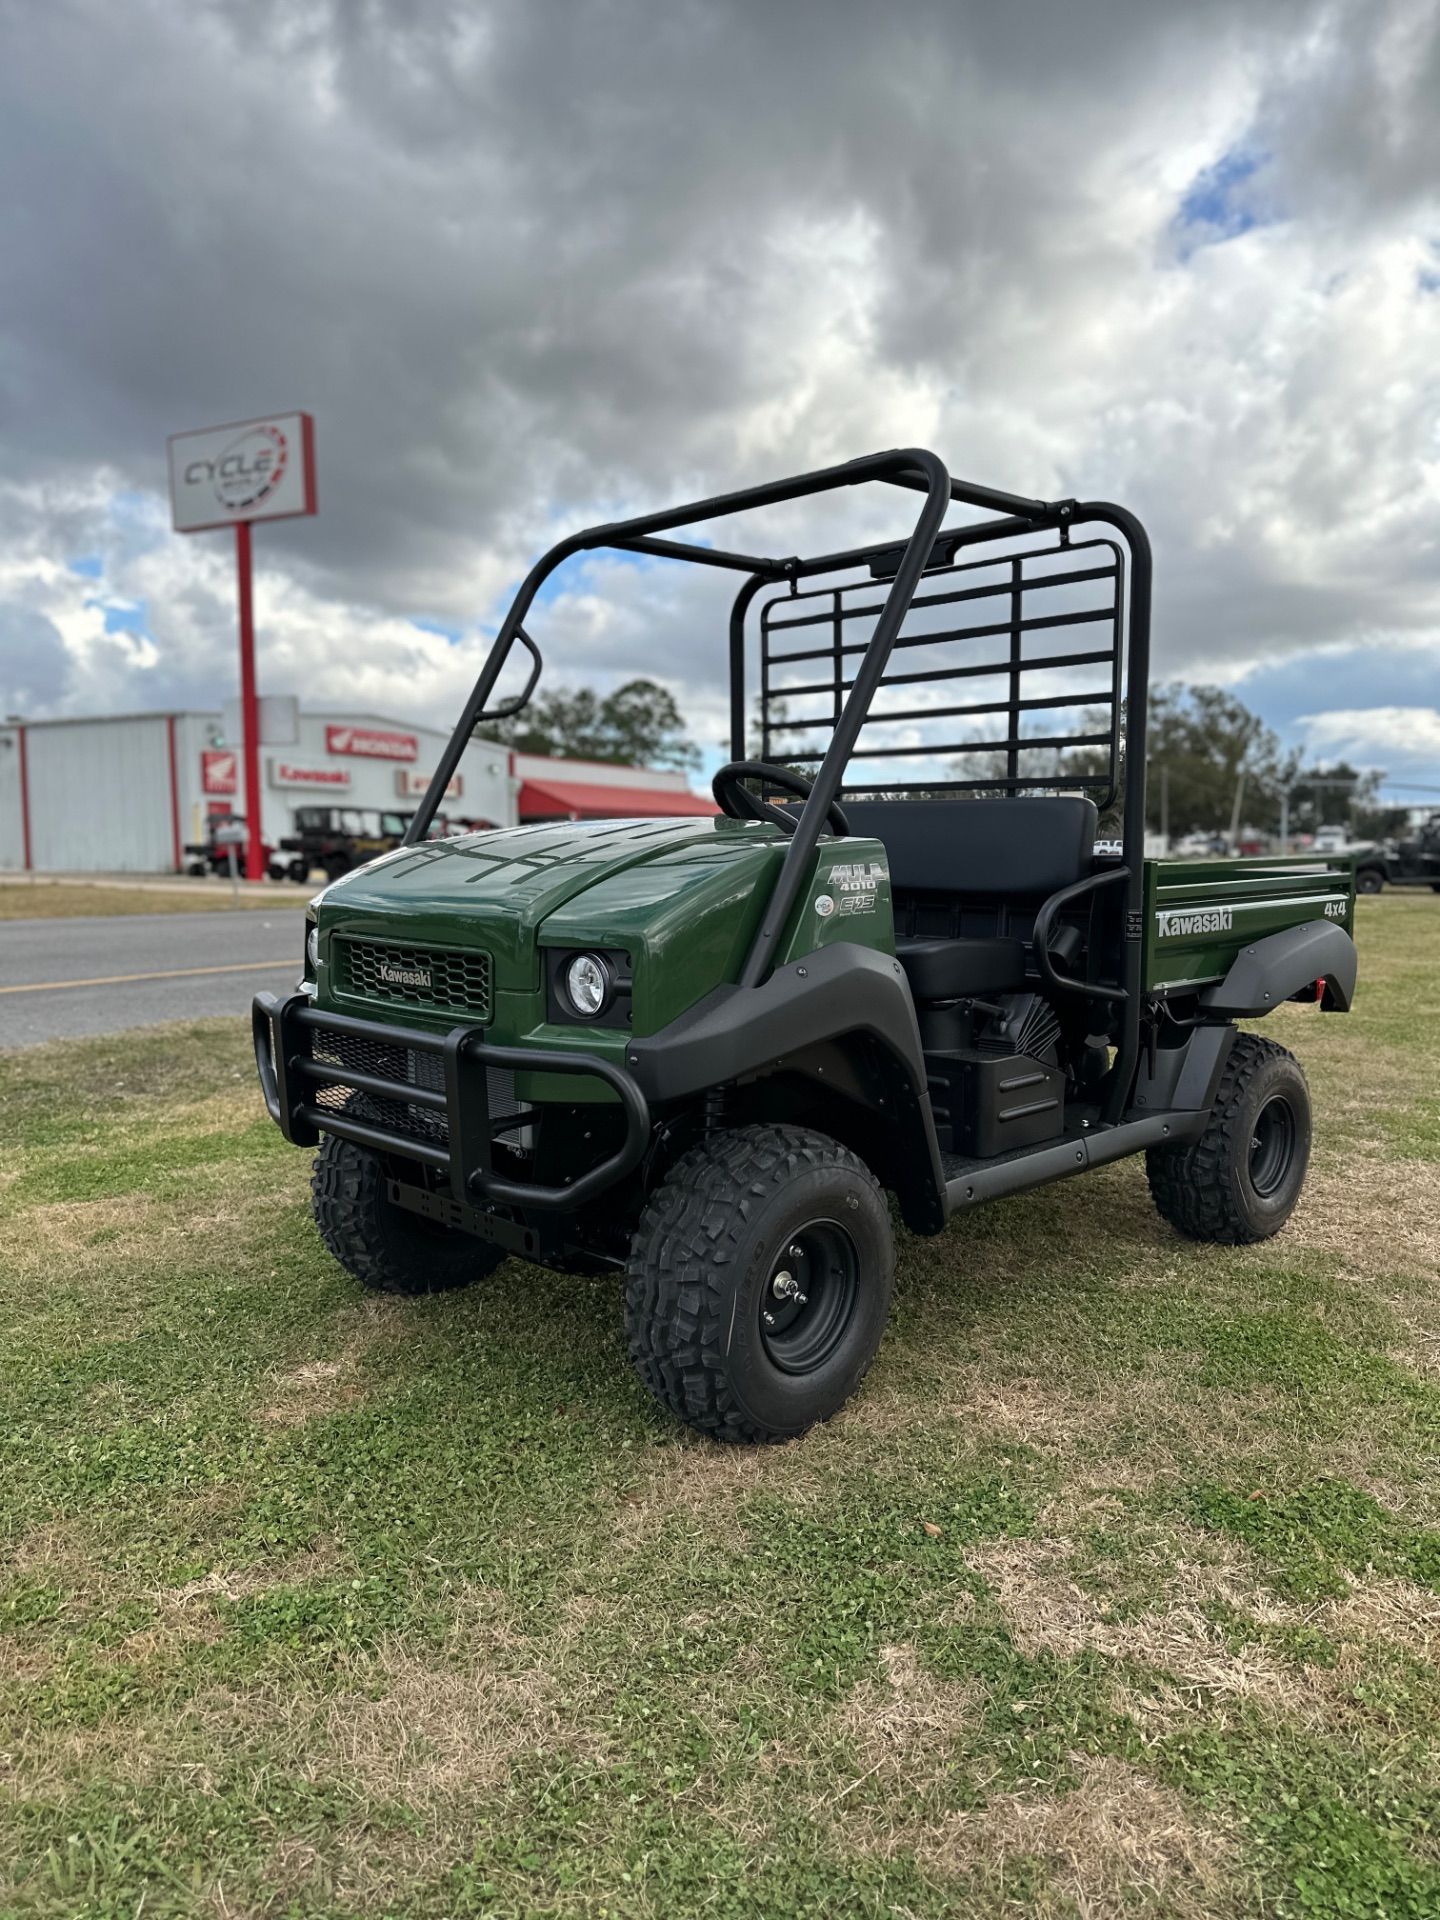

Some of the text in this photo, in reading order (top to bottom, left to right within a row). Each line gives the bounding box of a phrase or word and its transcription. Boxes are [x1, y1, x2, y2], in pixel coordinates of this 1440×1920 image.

[184, 454, 273, 485] CYCLE
[827, 863, 886, 884] MULE
[840, 881, 876, 891] 4010
[840, 895, 876, 913] EPS
[1324, 902, 1347, 917] 4x4
[1158, 906, 1233, 937] Kawasaki
[380, 965, 432, 987] Kawasaki
